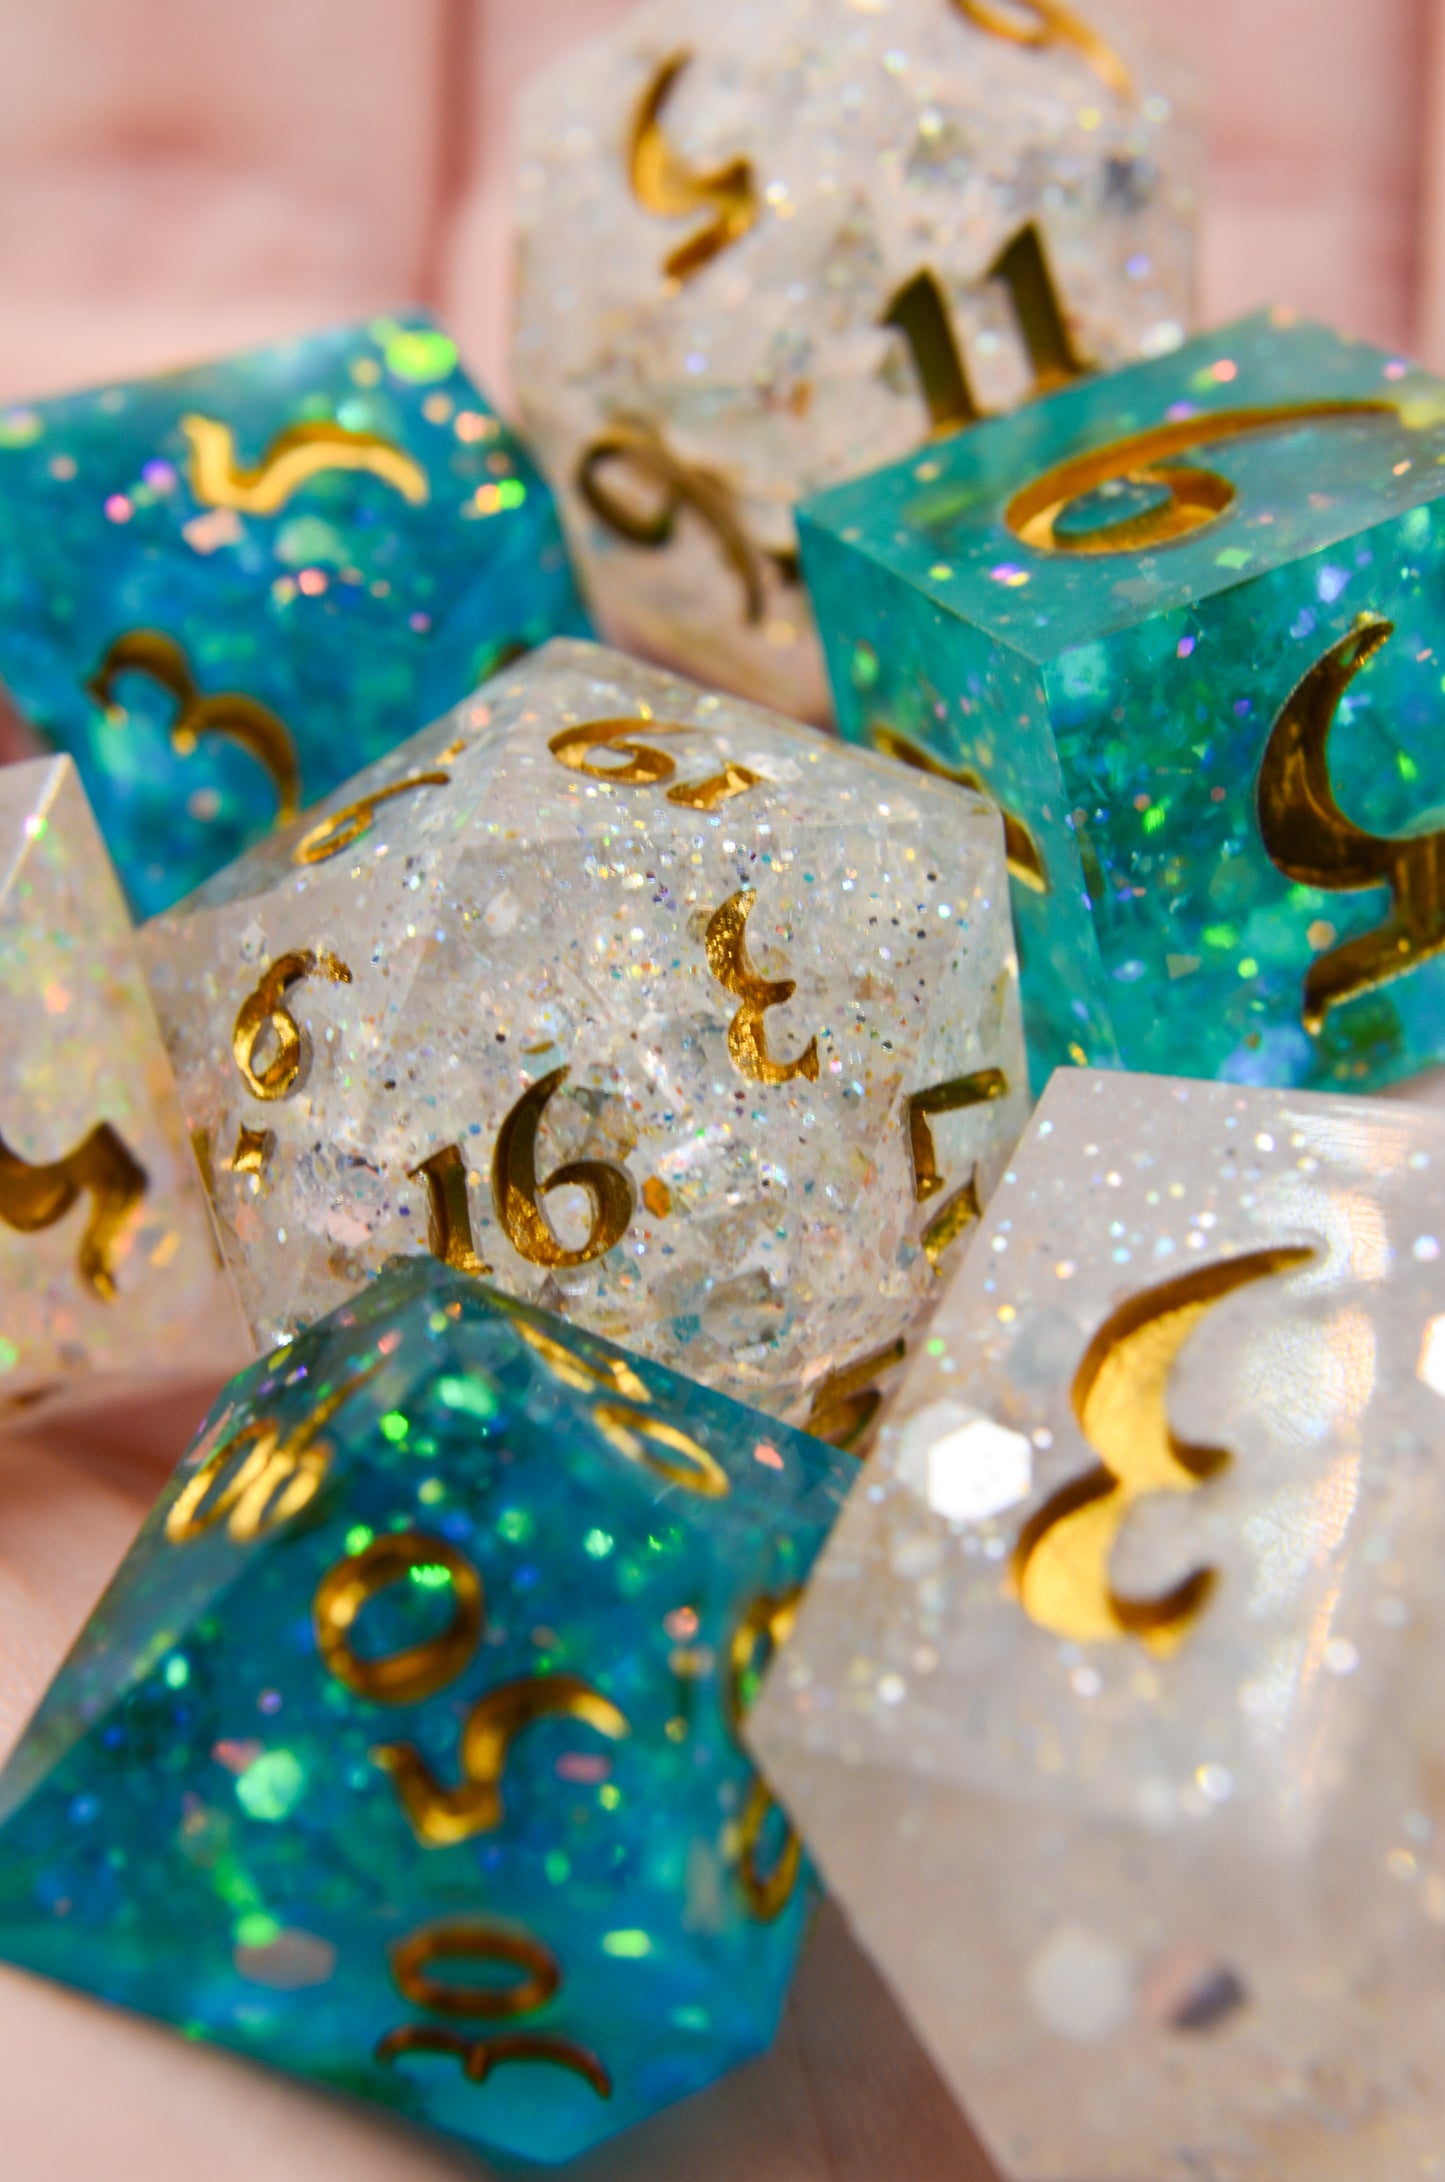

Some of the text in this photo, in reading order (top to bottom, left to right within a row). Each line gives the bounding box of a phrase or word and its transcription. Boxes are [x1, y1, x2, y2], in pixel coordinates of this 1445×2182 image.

[882, 222, 1096, 440] 11
[86, 630, 300, 828] 3
[703, 884, 822, 1086] 3
[406, 1063, 640, 1276] 16
[1008, 1244, 1320, 1660] 3
